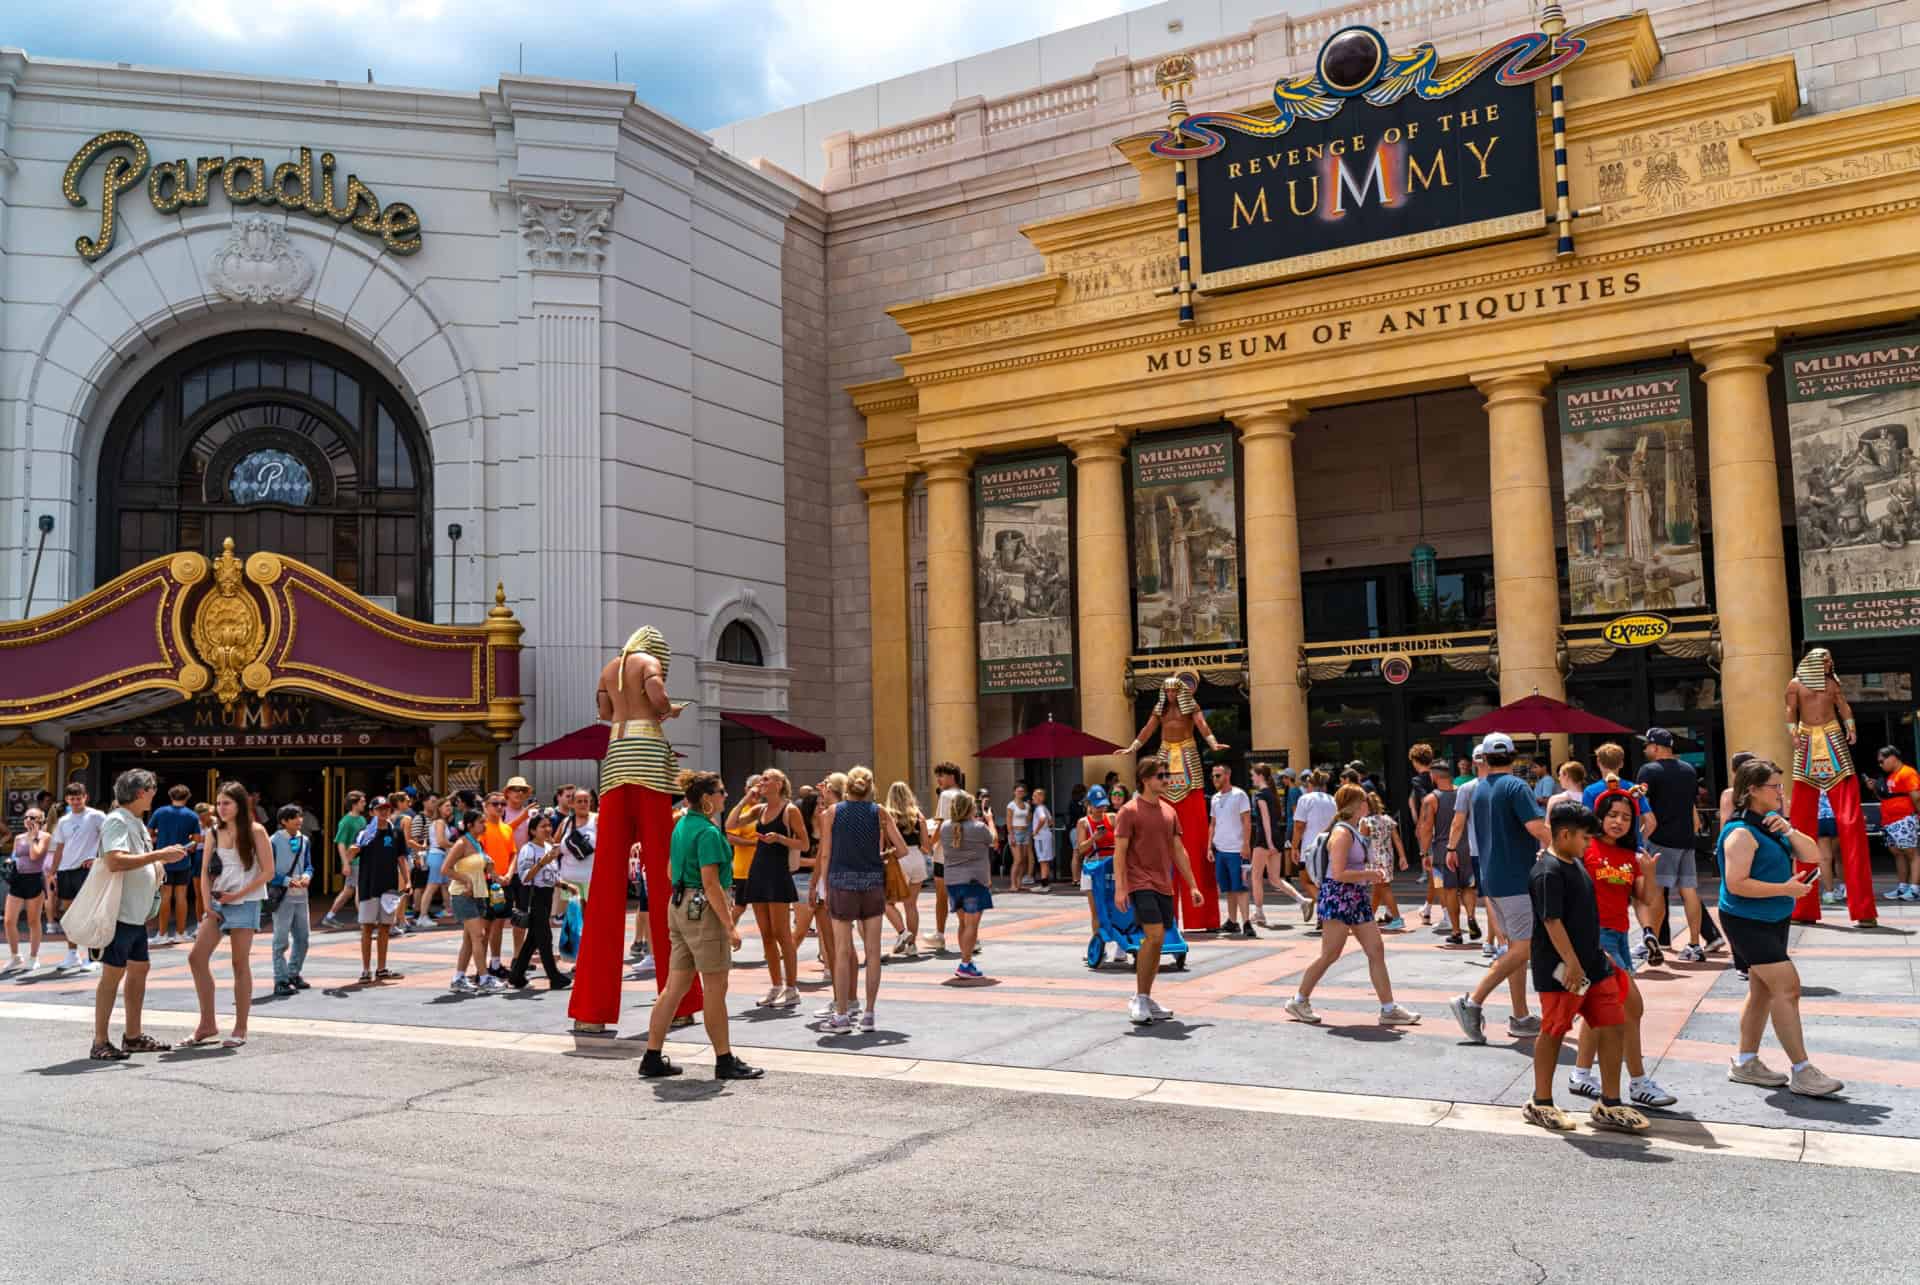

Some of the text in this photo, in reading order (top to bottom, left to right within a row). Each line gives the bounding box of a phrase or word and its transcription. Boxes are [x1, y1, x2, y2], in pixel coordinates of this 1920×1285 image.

[1227, 103, 1500, 179] REVENGE OF THE
[1229, 136, 1500, 230] MUMMY
[62, 129, 423, 262] Paradise
[1147, 272, 1643, 373] MUSEUM OF ANTIQUITIES
[1794, 345, 1920, 374] MUMMY
[1823, 376, 1848, 385] THE
[1854, 366, 1920, 380] MUSEUM
[1567, 379, 1680, 406] MUMMY
[1799, 387, 1819, 396] OF
[1591, 407, 1616, 417] THE
[1619, 398, 1680, 413] MUSEUM
[1593, 407, 1679, 424] ANTIQUITIES
[1138, 442, 1224, 465] MUMMY
[981, 464, 1059, 485] MUMMY
[1141, 460, 1226, 476] AT THE MUSEUM
[1159, 467, 1224, 480] ANTIQUITIES
[257, 461, 284, 498] P
[1815, 597, 1920, 611] THE CURSES
[1816, 617, 1920, 631] THE PHARAO
[1824, 608, 1904, 621] LEGENDS
[1610, 622, 1665, 644] EXPRESS
[1341, 638, 1454, 656] SINGLE RIDERS
[1148, 654, 1229, 669] ENTRANCE
[194, 704, 311, 728] MUMMY
[161, 734, 344, 747] LOCKER ENTRANCE
